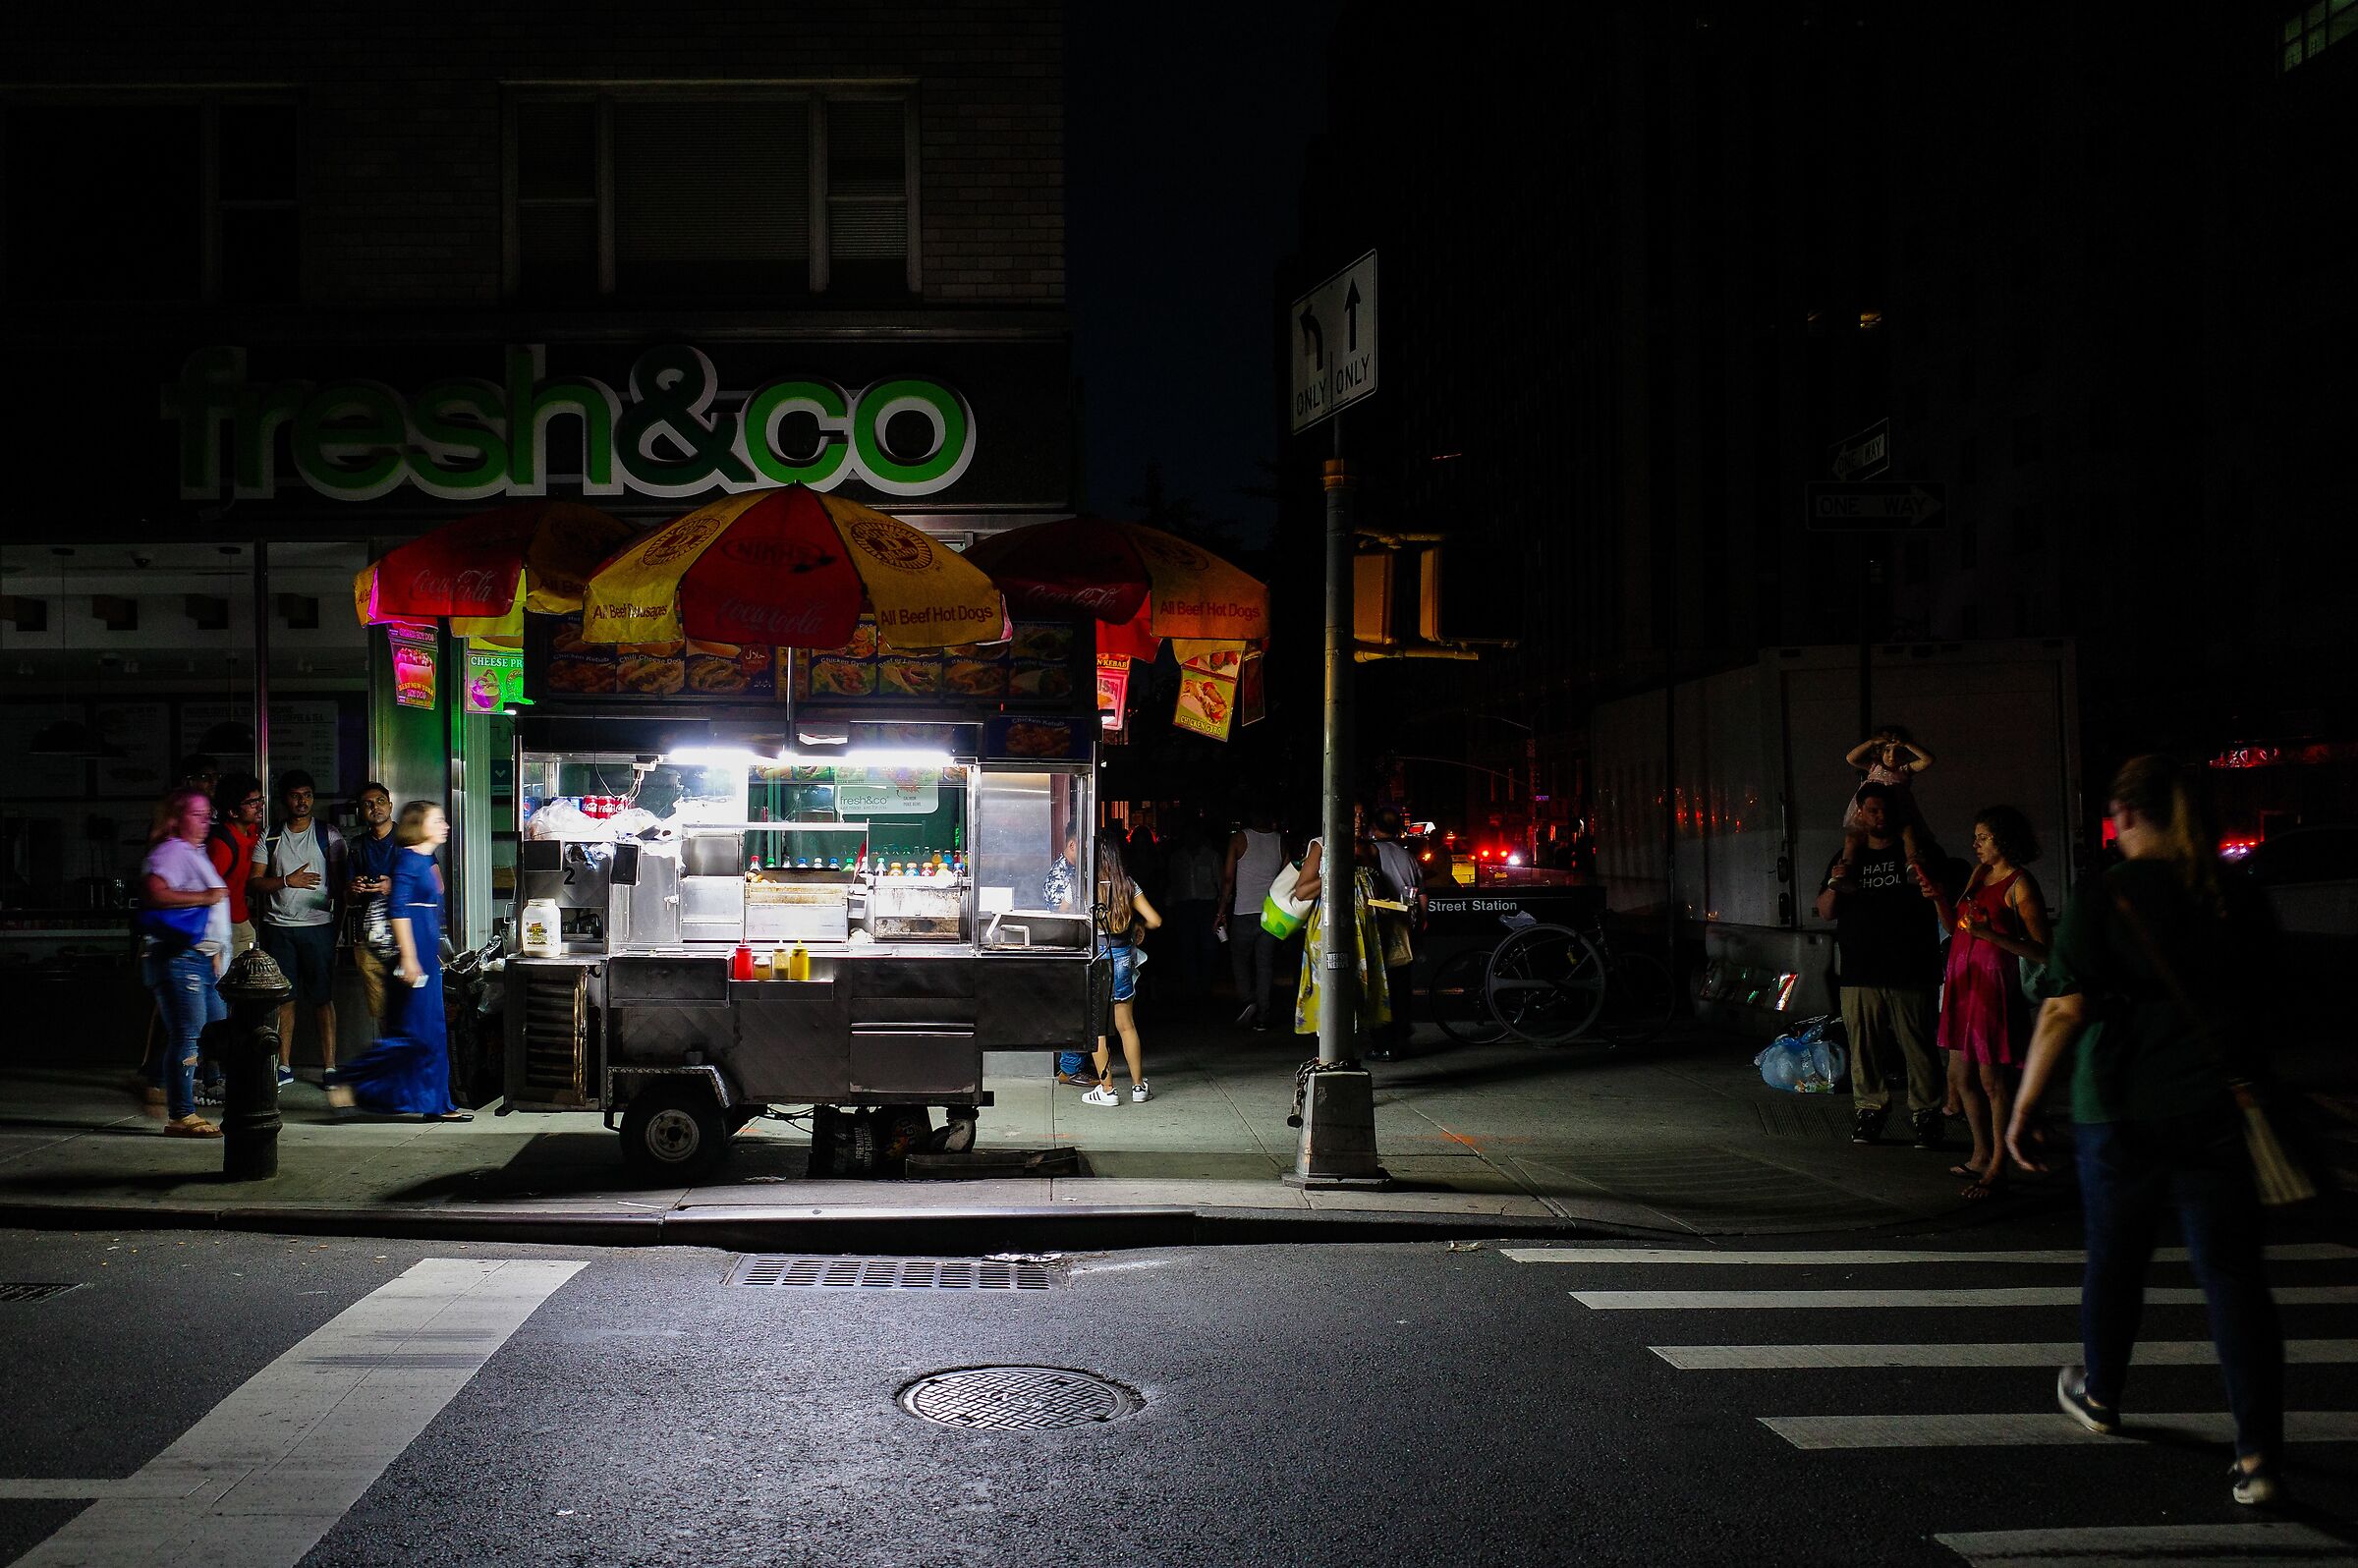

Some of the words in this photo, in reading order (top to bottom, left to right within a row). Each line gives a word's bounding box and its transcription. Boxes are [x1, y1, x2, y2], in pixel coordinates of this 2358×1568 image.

[1336, 353, 1371, 394] ONLY
[1296, 377, 1327, 417] ONLY
[159, 344, 977, 499] fresh&co
[1821, 497, 1859, 515] ONE
[1885, 497, 1927, 515] WAY
[609, 603, 626, 619] Beef
[880, 609, 896, 625] All
[899, 607, 930, 625] Beef
[933, 606, 956, 623] Hot
[958, 604, 993, 623] Dogs
[1159, 600, 1175, 615] All
[1177, 600, 1205, 615] Beef
[1207, 602, 1226, 616] Hot
[1229, 602, 1261, 621] Dogs
[471, 655, 509, 667] CHEESE
[1103, 659, 1128, 668] KEBAB
[1180, 714, 1206, 732] CHICKEN
[1206, 722, 1223, 736] GYRO
[840, 796, 887, 806] fresh&co
[563, 868, 576, 885] 2
[1863, 861, 1895, 875] HATE
[1428, 899, 1467, 913] Street
[1472, 899, 1518, 912] Station
